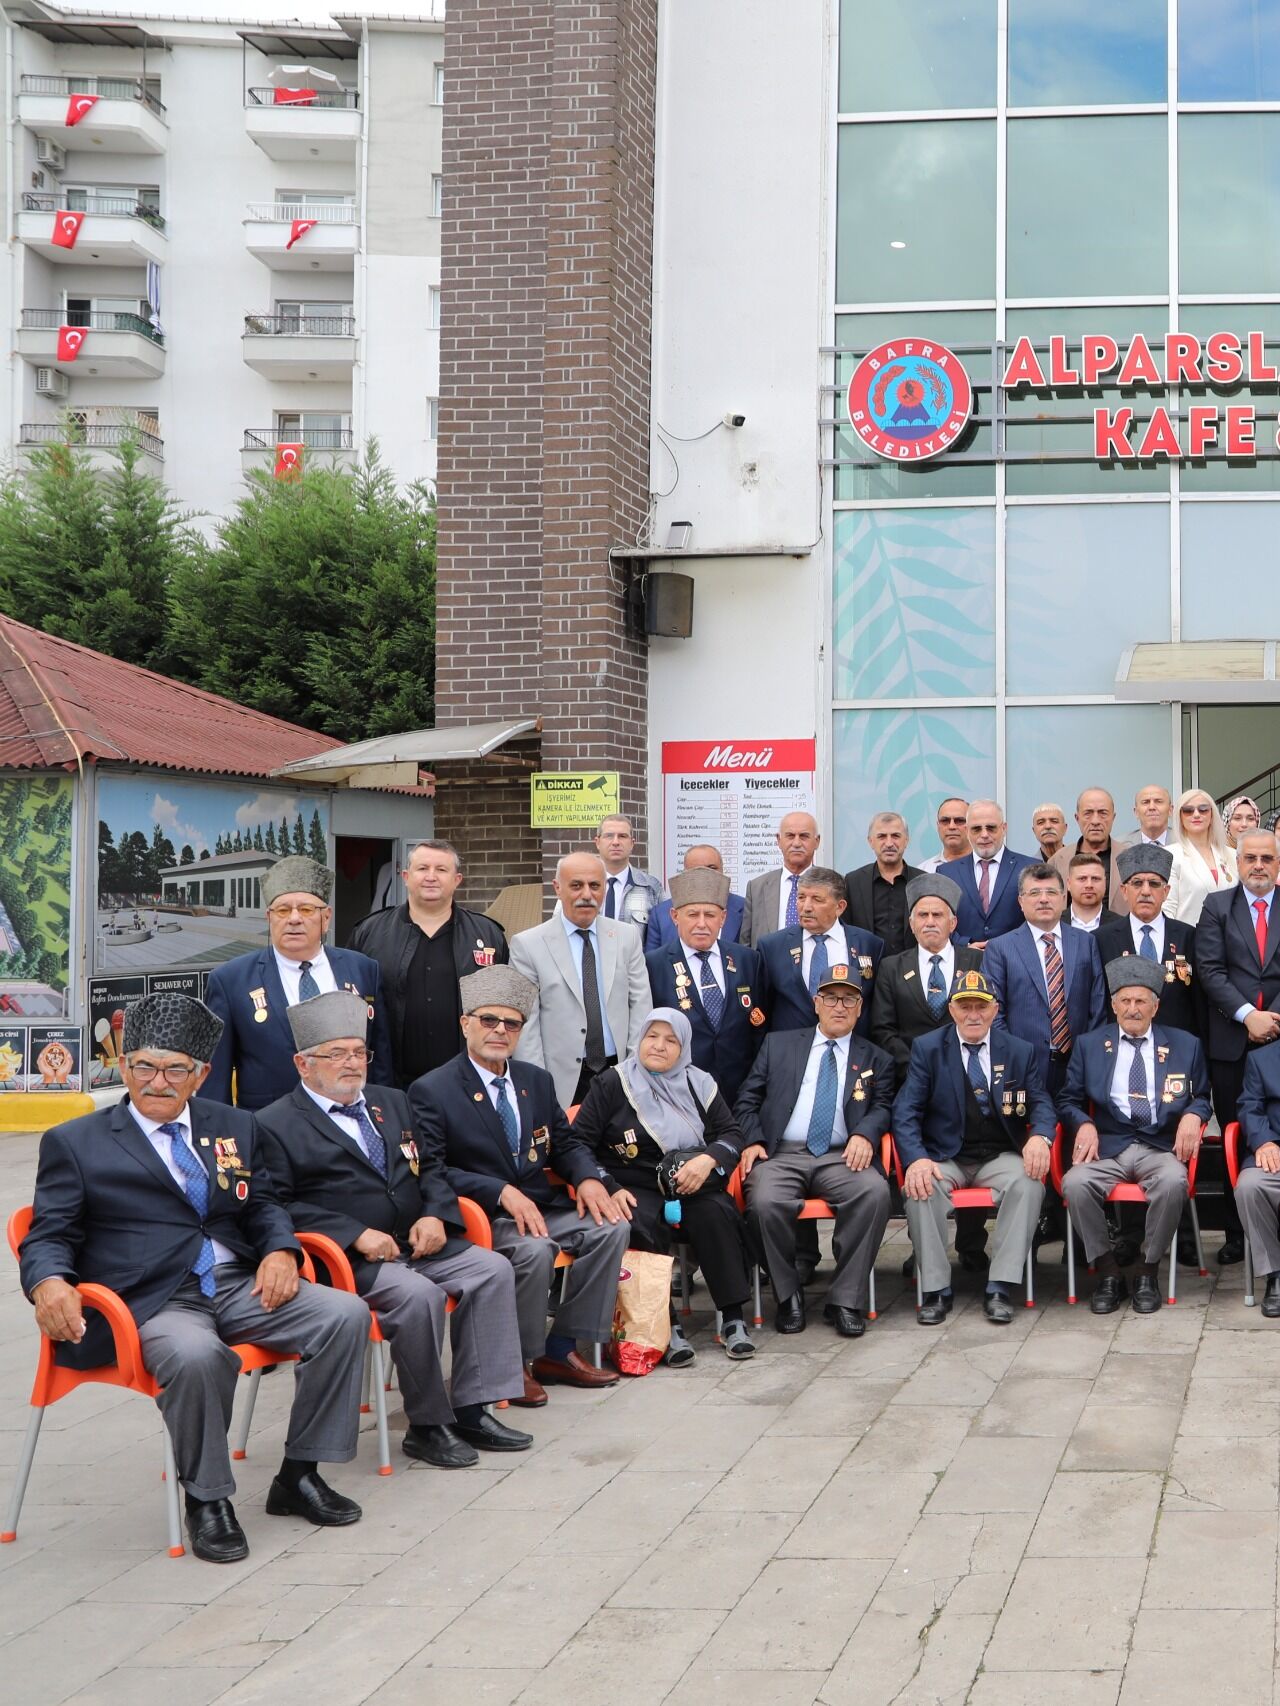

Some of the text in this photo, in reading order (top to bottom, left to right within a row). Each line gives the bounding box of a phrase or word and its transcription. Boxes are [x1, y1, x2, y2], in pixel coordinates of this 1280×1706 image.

[868, 343, 949, 370] BAFRA
[852, 410, 966, 457] BELEDİYESİ
[1093, 405, 1257, 458] KAFE
[703, 745, 774, 768] Menü
[547, 779, 582, 789] DİKKAT
[680, 777, 730, 790] İçecekler
[745, 778, 800, 790] Yiyecekler
[154, 979, 194, 990] SEMAVER ÇAY
